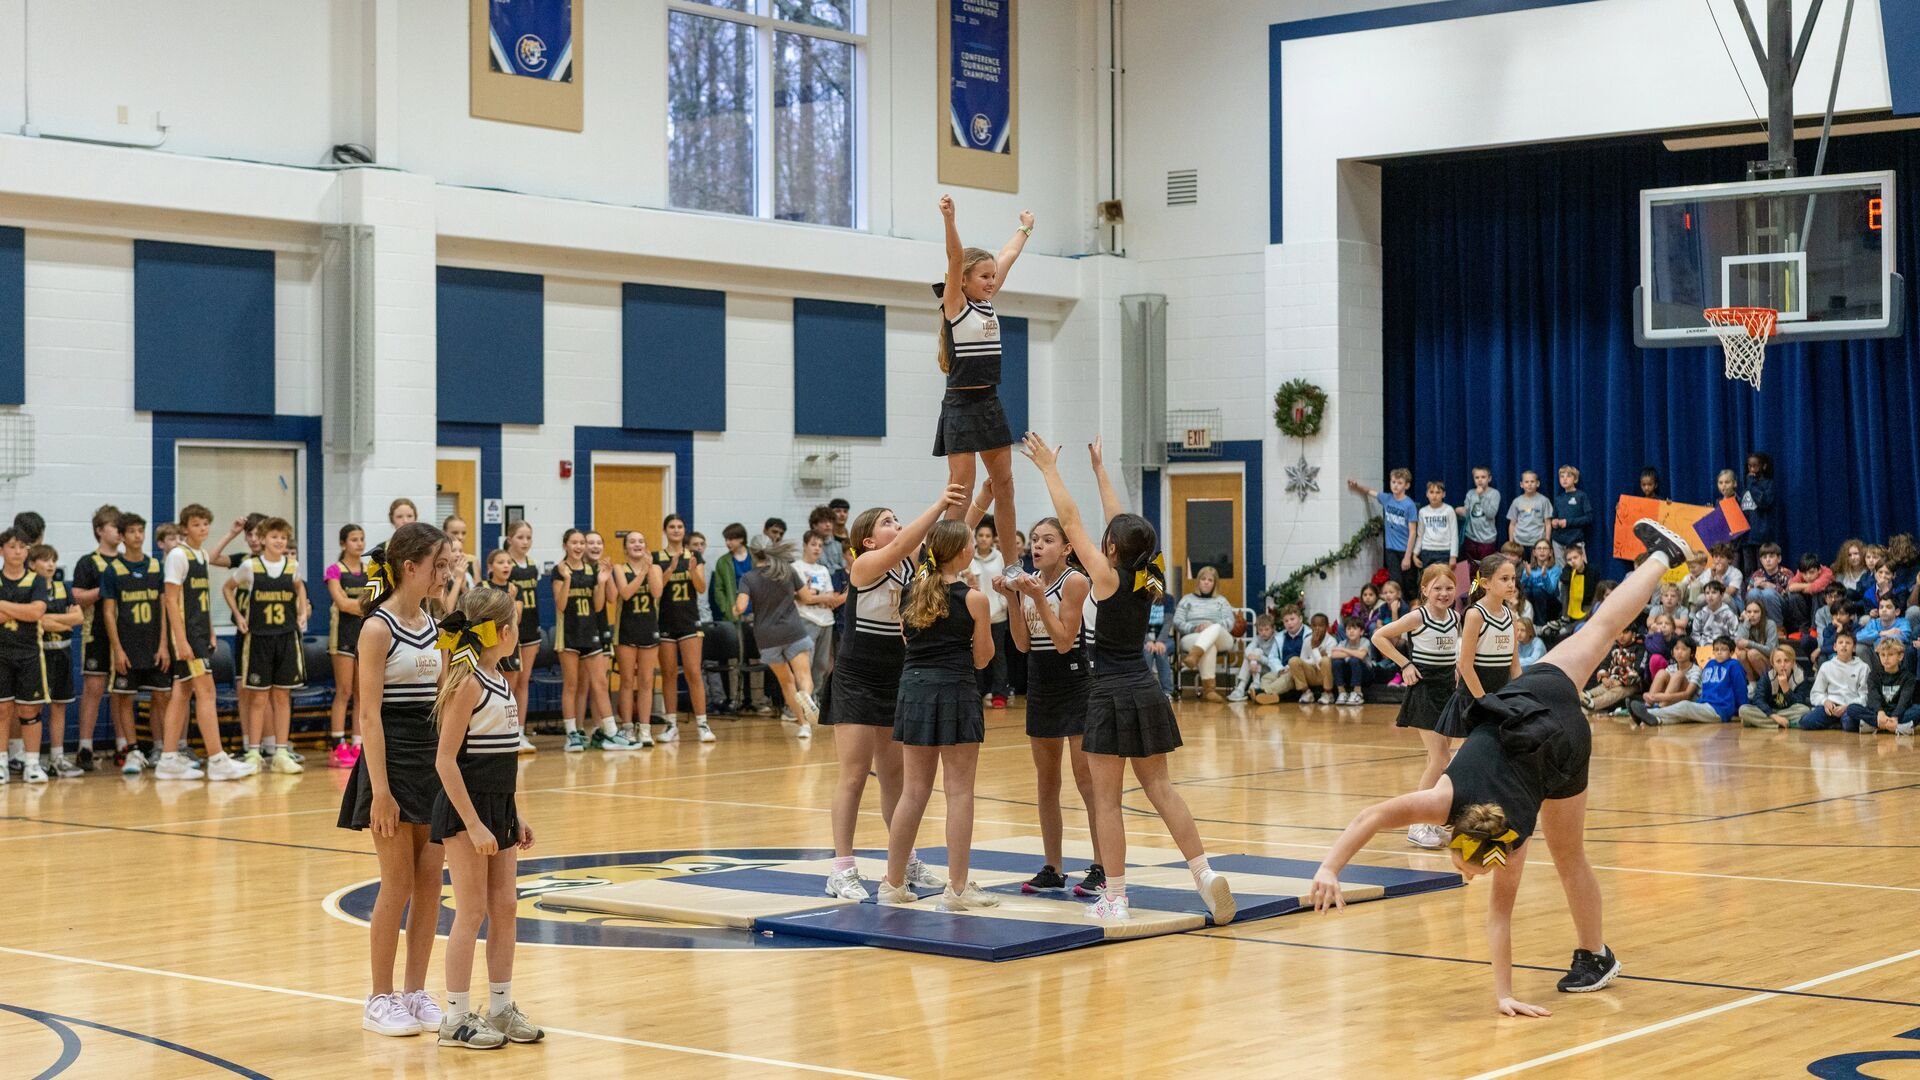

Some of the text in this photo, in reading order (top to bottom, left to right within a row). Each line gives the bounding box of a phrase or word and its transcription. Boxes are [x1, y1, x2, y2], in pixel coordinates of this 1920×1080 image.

[963, 3, 998, 18] CHAMPIONS
[961, 51, 1000, 66] CONFERENCE
[960, 59, 1001, 75] TOURNAMENT
[963, 69, 999, 83] CHAMPIONS
[1187, 429, 1205, 446] EXIT
[1424, 515, 1447, 524] TIGER
[523, 590, 536, 609] 11
[672, 582, 691, 602] 21
[576, 598, 590, 617] 10
[632, 595, 651, 614] 12
[131, 602, 152, 624] 10
[263, 603, 286, 625] 13
[1436, 636, 1454, 645] TIGERS
[1495, 635, 1510, 644] TIGERS
[415, 655, 438, 668] TIGERS
